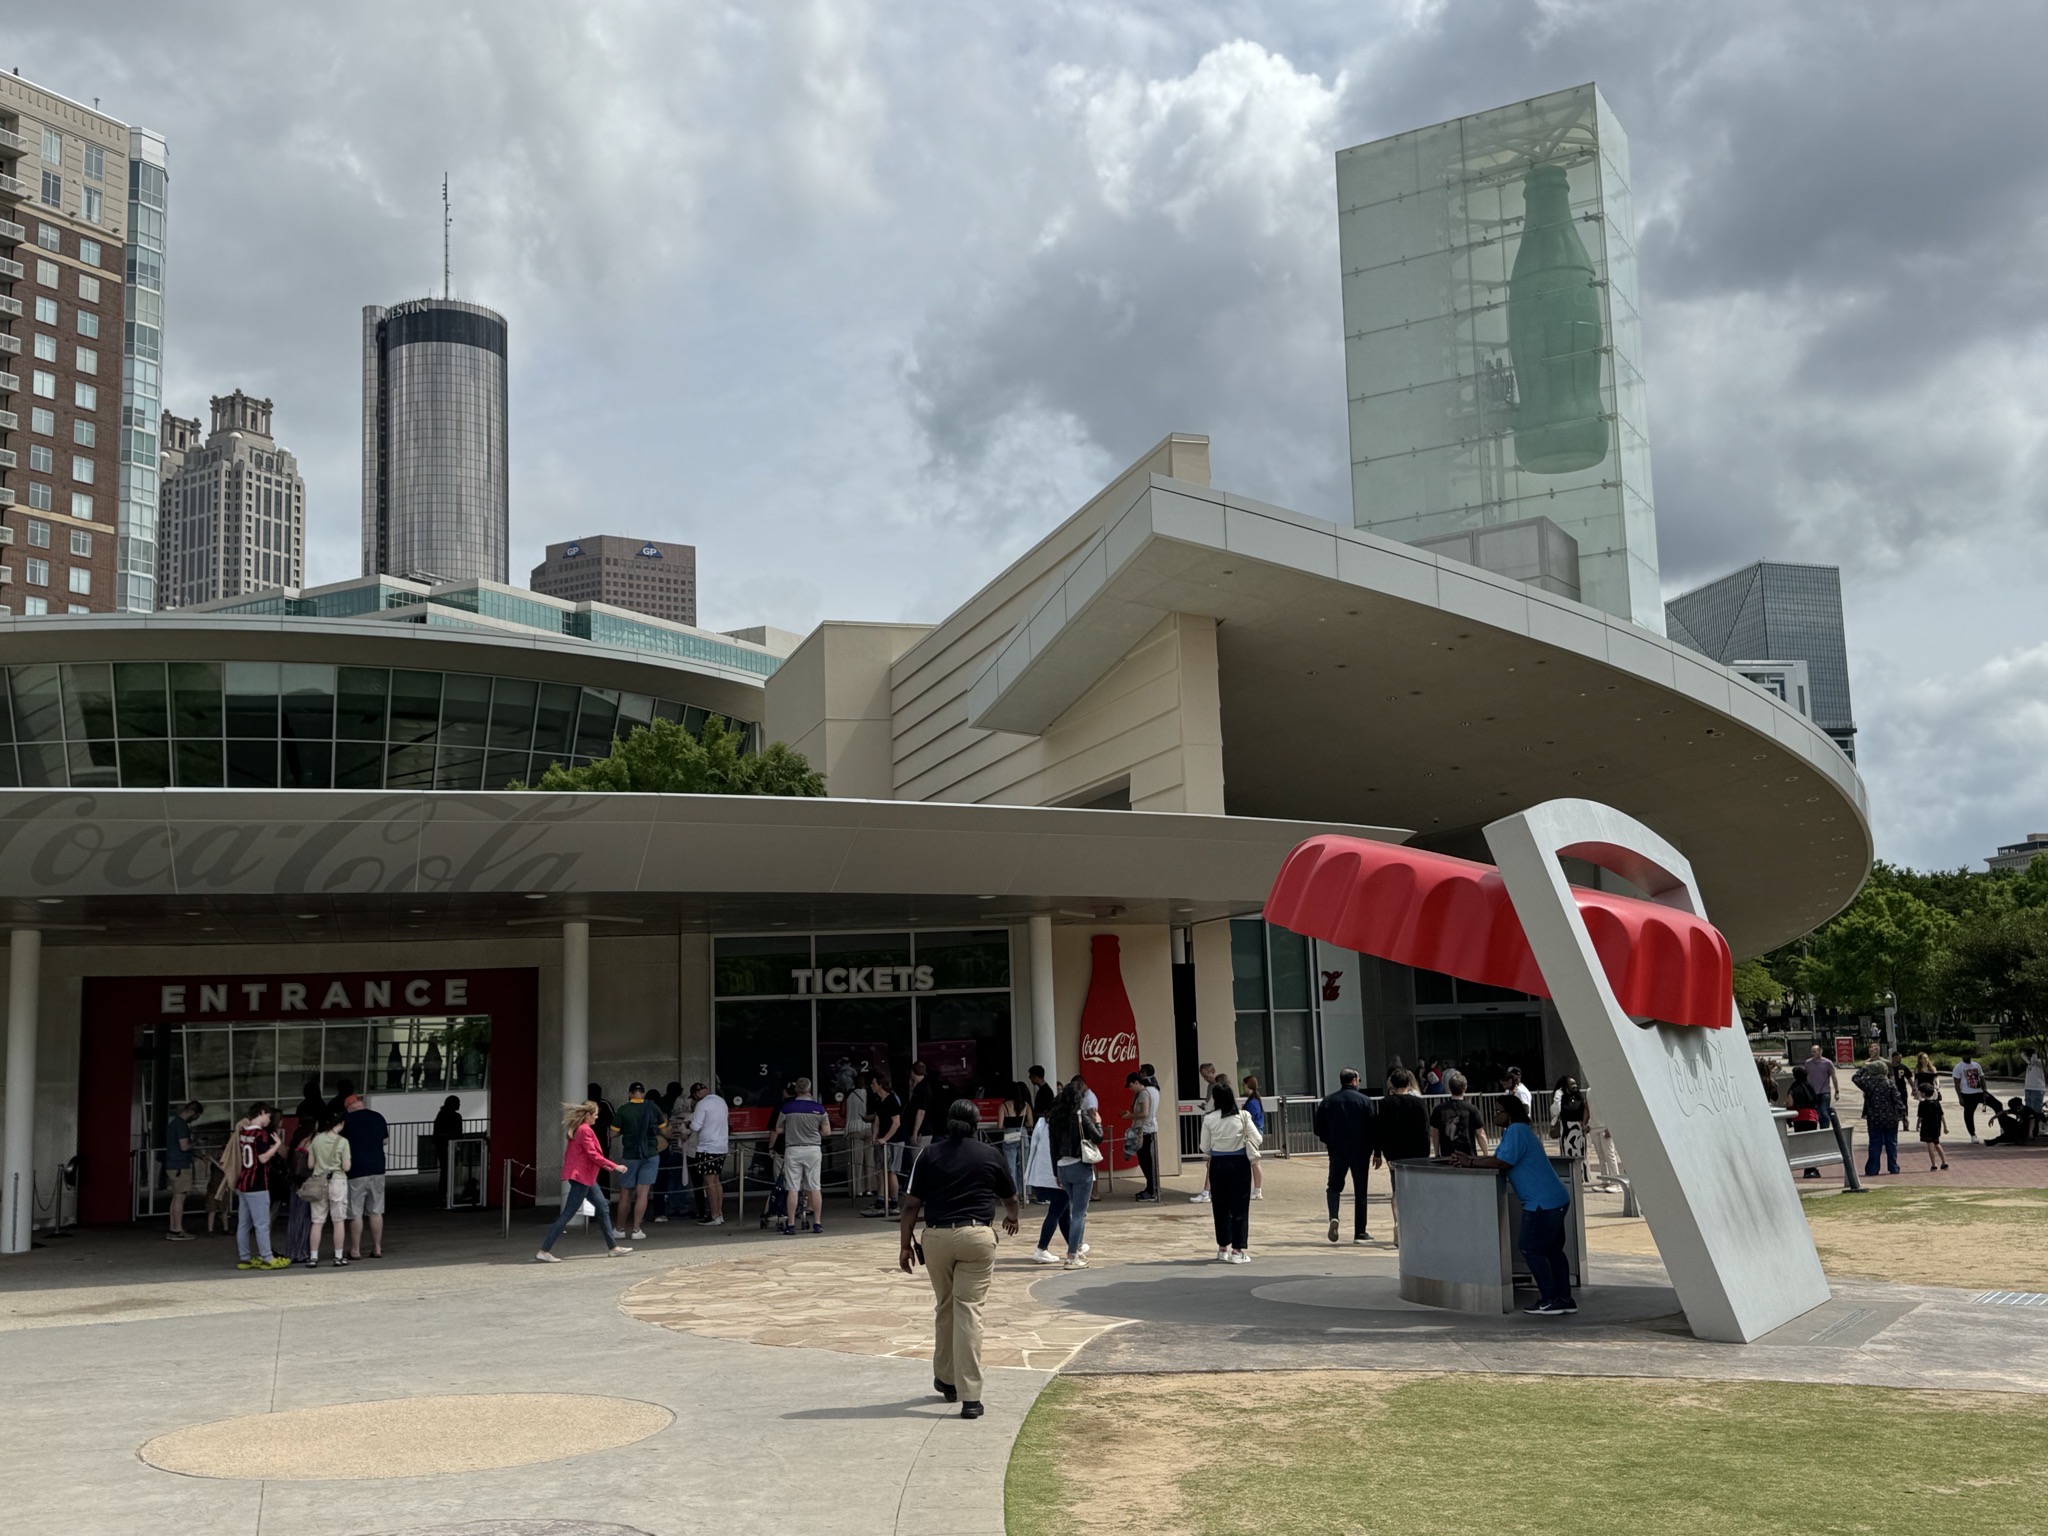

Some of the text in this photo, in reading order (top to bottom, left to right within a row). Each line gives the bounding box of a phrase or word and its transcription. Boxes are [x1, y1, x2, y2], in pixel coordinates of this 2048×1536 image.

[567, 547, 580, 556] GP
[642, 547, 658, 556] GP
[791, 964, 935, 994] TICKETS
[161, 979, 468, 1014] ENTRANCE
[1082, 1031, 1138, 1064] Coca-Cola
[860, 1060, 870, 1073] 2
[960, 1056, 967, 1069] 1
[759, 1064, 769, 1076] 3
[1897, 1069, 1905, 1079] P
